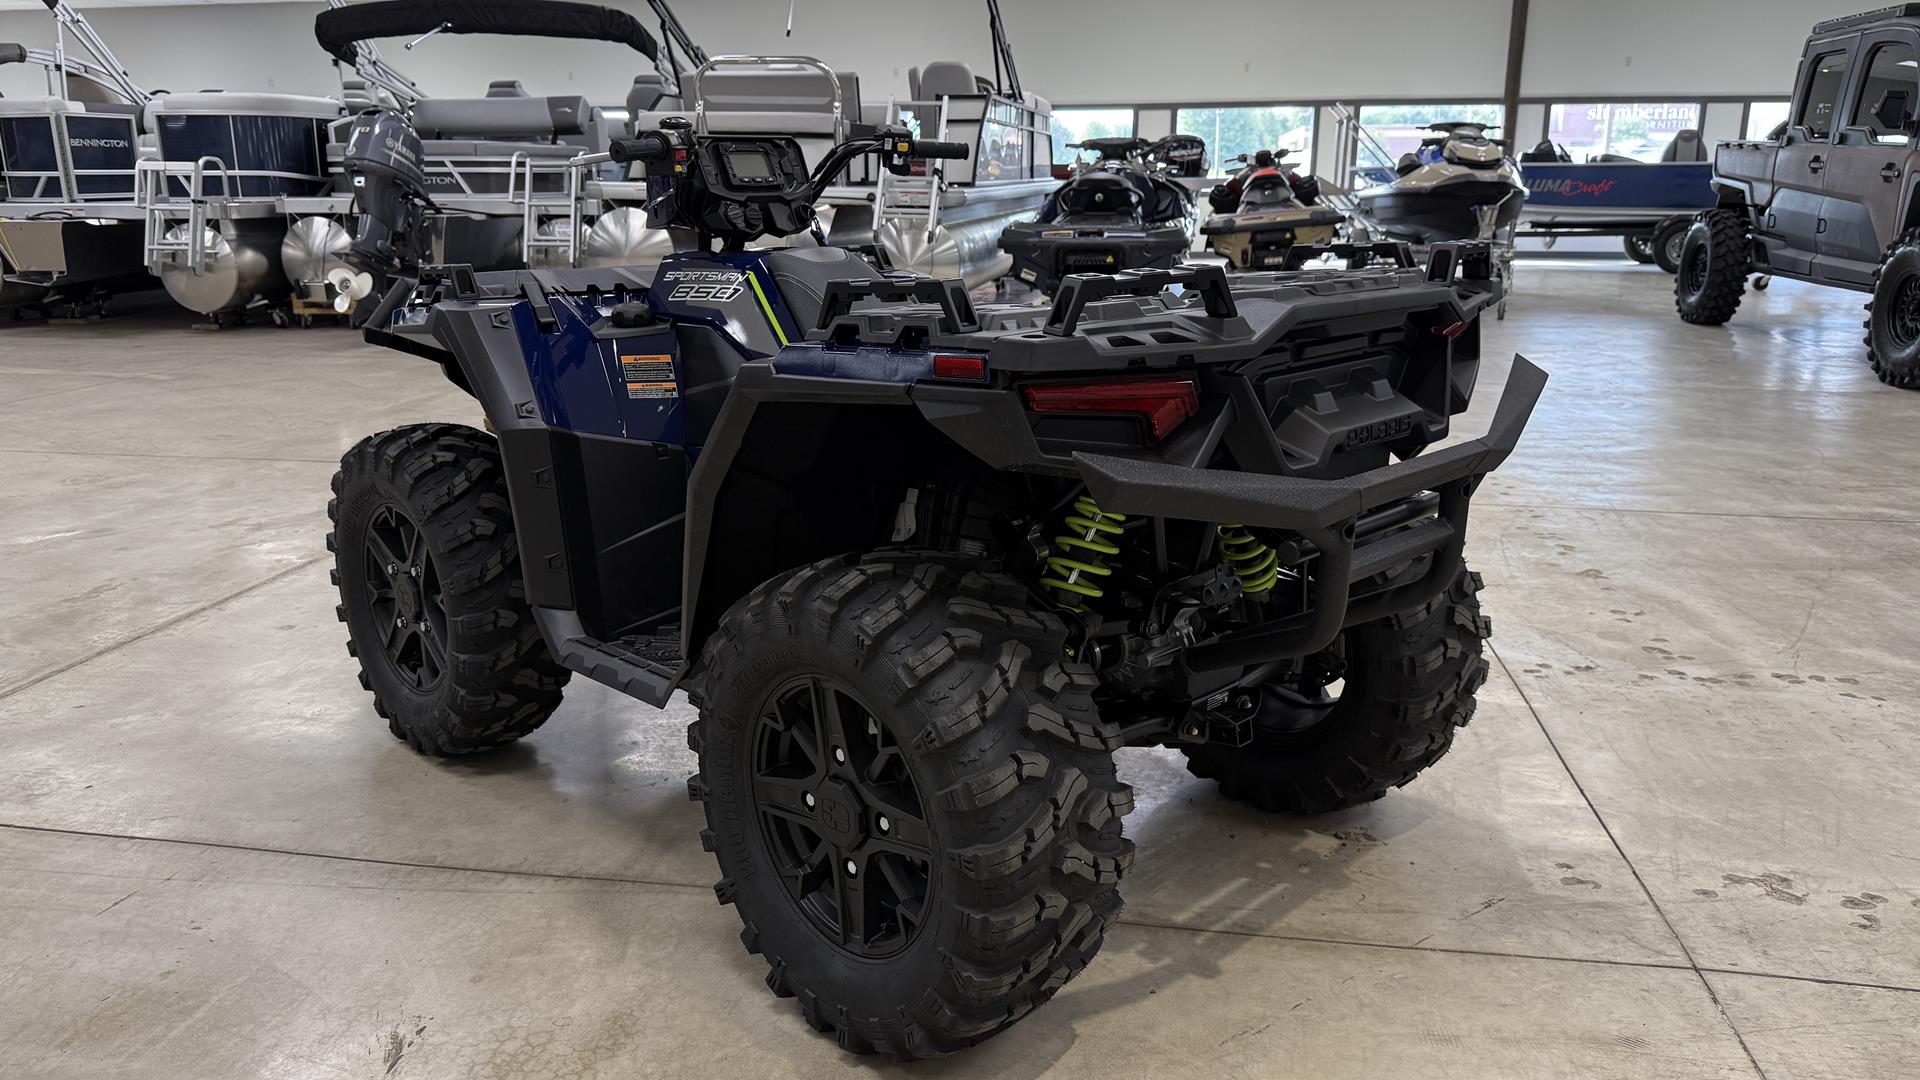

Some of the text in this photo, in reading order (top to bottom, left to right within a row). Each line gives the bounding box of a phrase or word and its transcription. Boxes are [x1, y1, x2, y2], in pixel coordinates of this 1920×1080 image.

[70, 138, 129, 148] BENNINGTON
[663, 271, 747, 282] SPORTSMAN
[668, 284, 744, 302] 850
